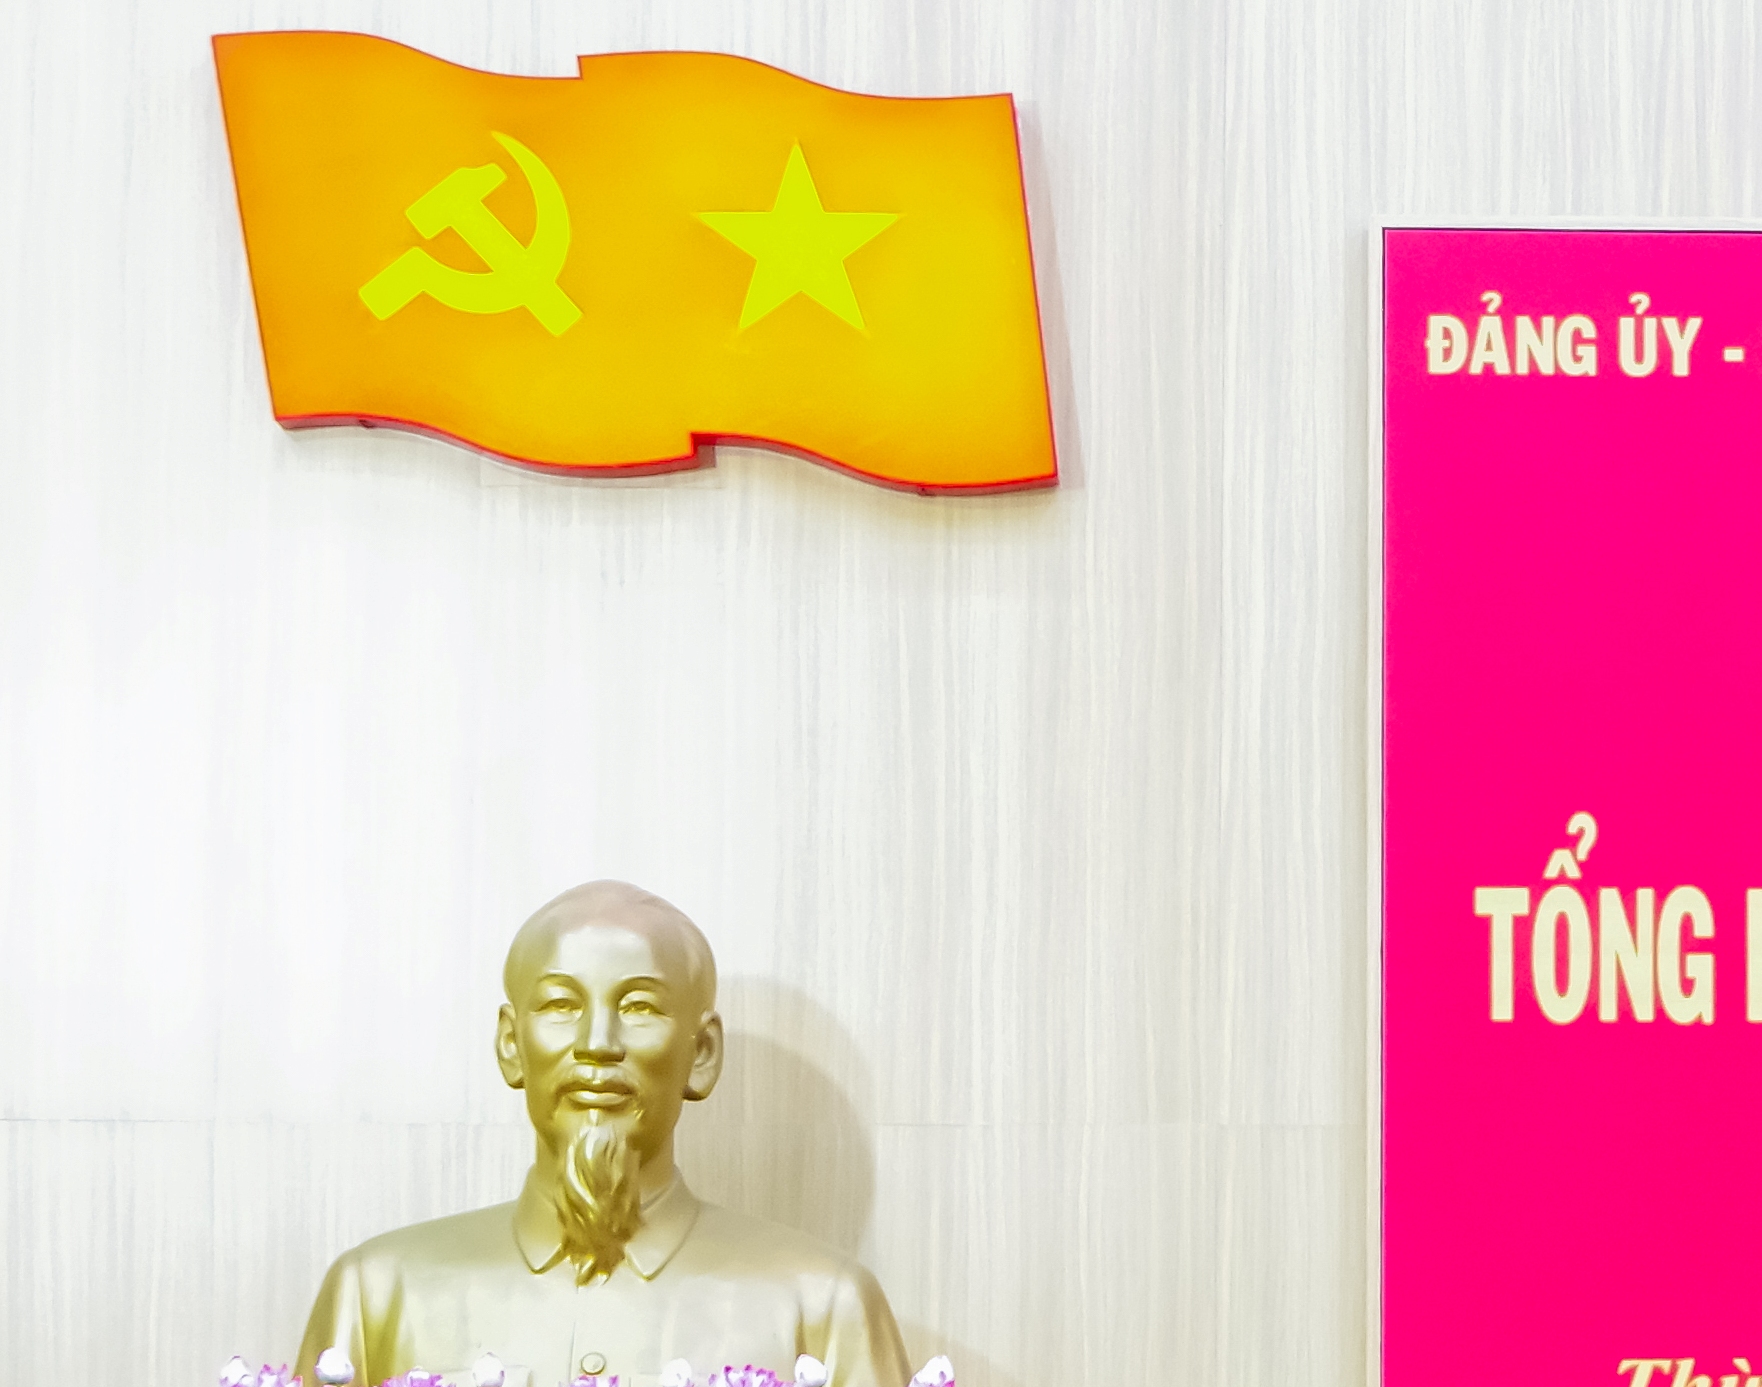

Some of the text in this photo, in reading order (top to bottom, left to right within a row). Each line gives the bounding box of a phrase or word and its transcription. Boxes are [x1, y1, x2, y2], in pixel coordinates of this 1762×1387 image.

[1425, 291, 1597, 377] ĐẢNG
[1618, 293, 1702, 377] ỦY
[1722, 345, 1746, 364] -
[1474, 812, 1714, 1025] TỔNG
